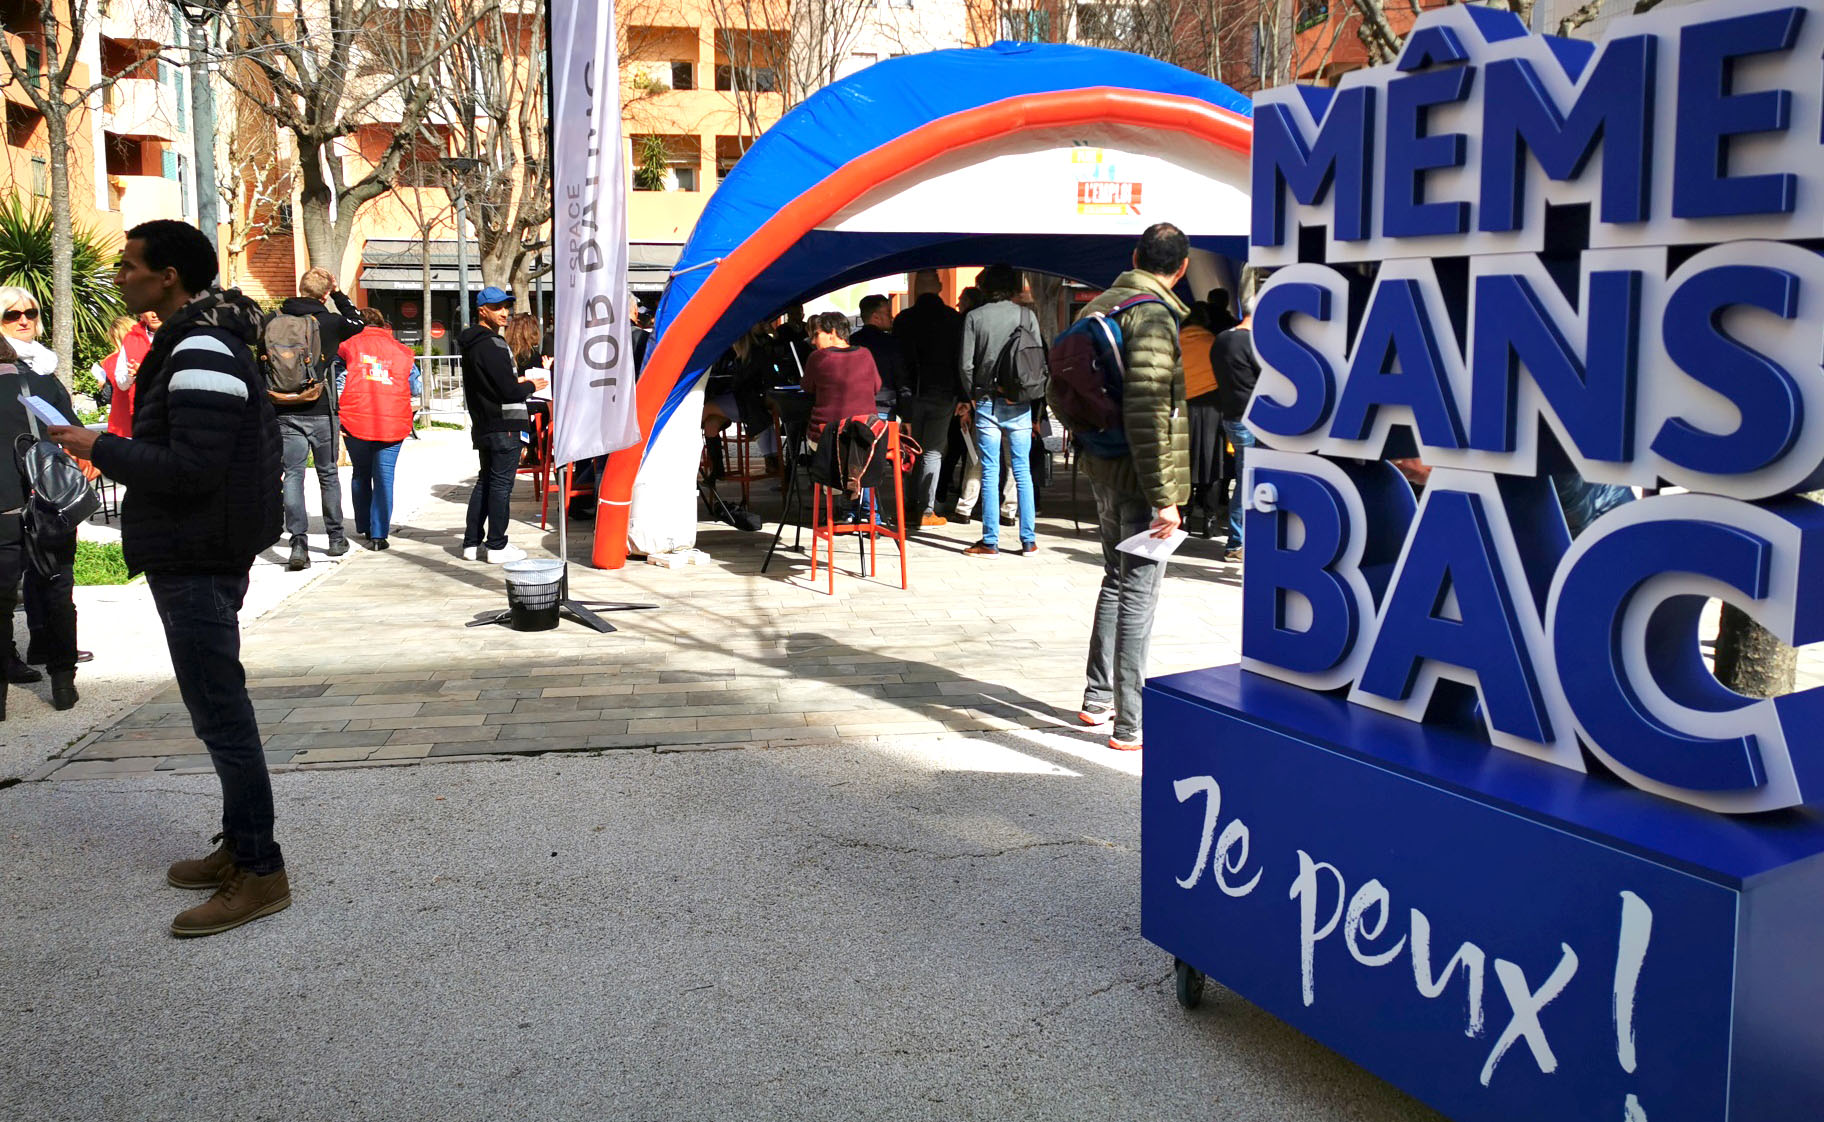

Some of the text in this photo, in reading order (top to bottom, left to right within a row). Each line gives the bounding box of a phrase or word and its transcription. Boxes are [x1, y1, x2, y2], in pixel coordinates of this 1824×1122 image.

[567, 182, 582, 288] ESPACE
[1251, 5, 1807, 247] MÊME
[583, 294, 619, 403] JOB
[1249, 265, 1804, 476] SANS
[1245, 468, 1773, 792] BAC
[1173, 775, 1264, 898] Je
[1288, 849, 1579, 1087] peux
